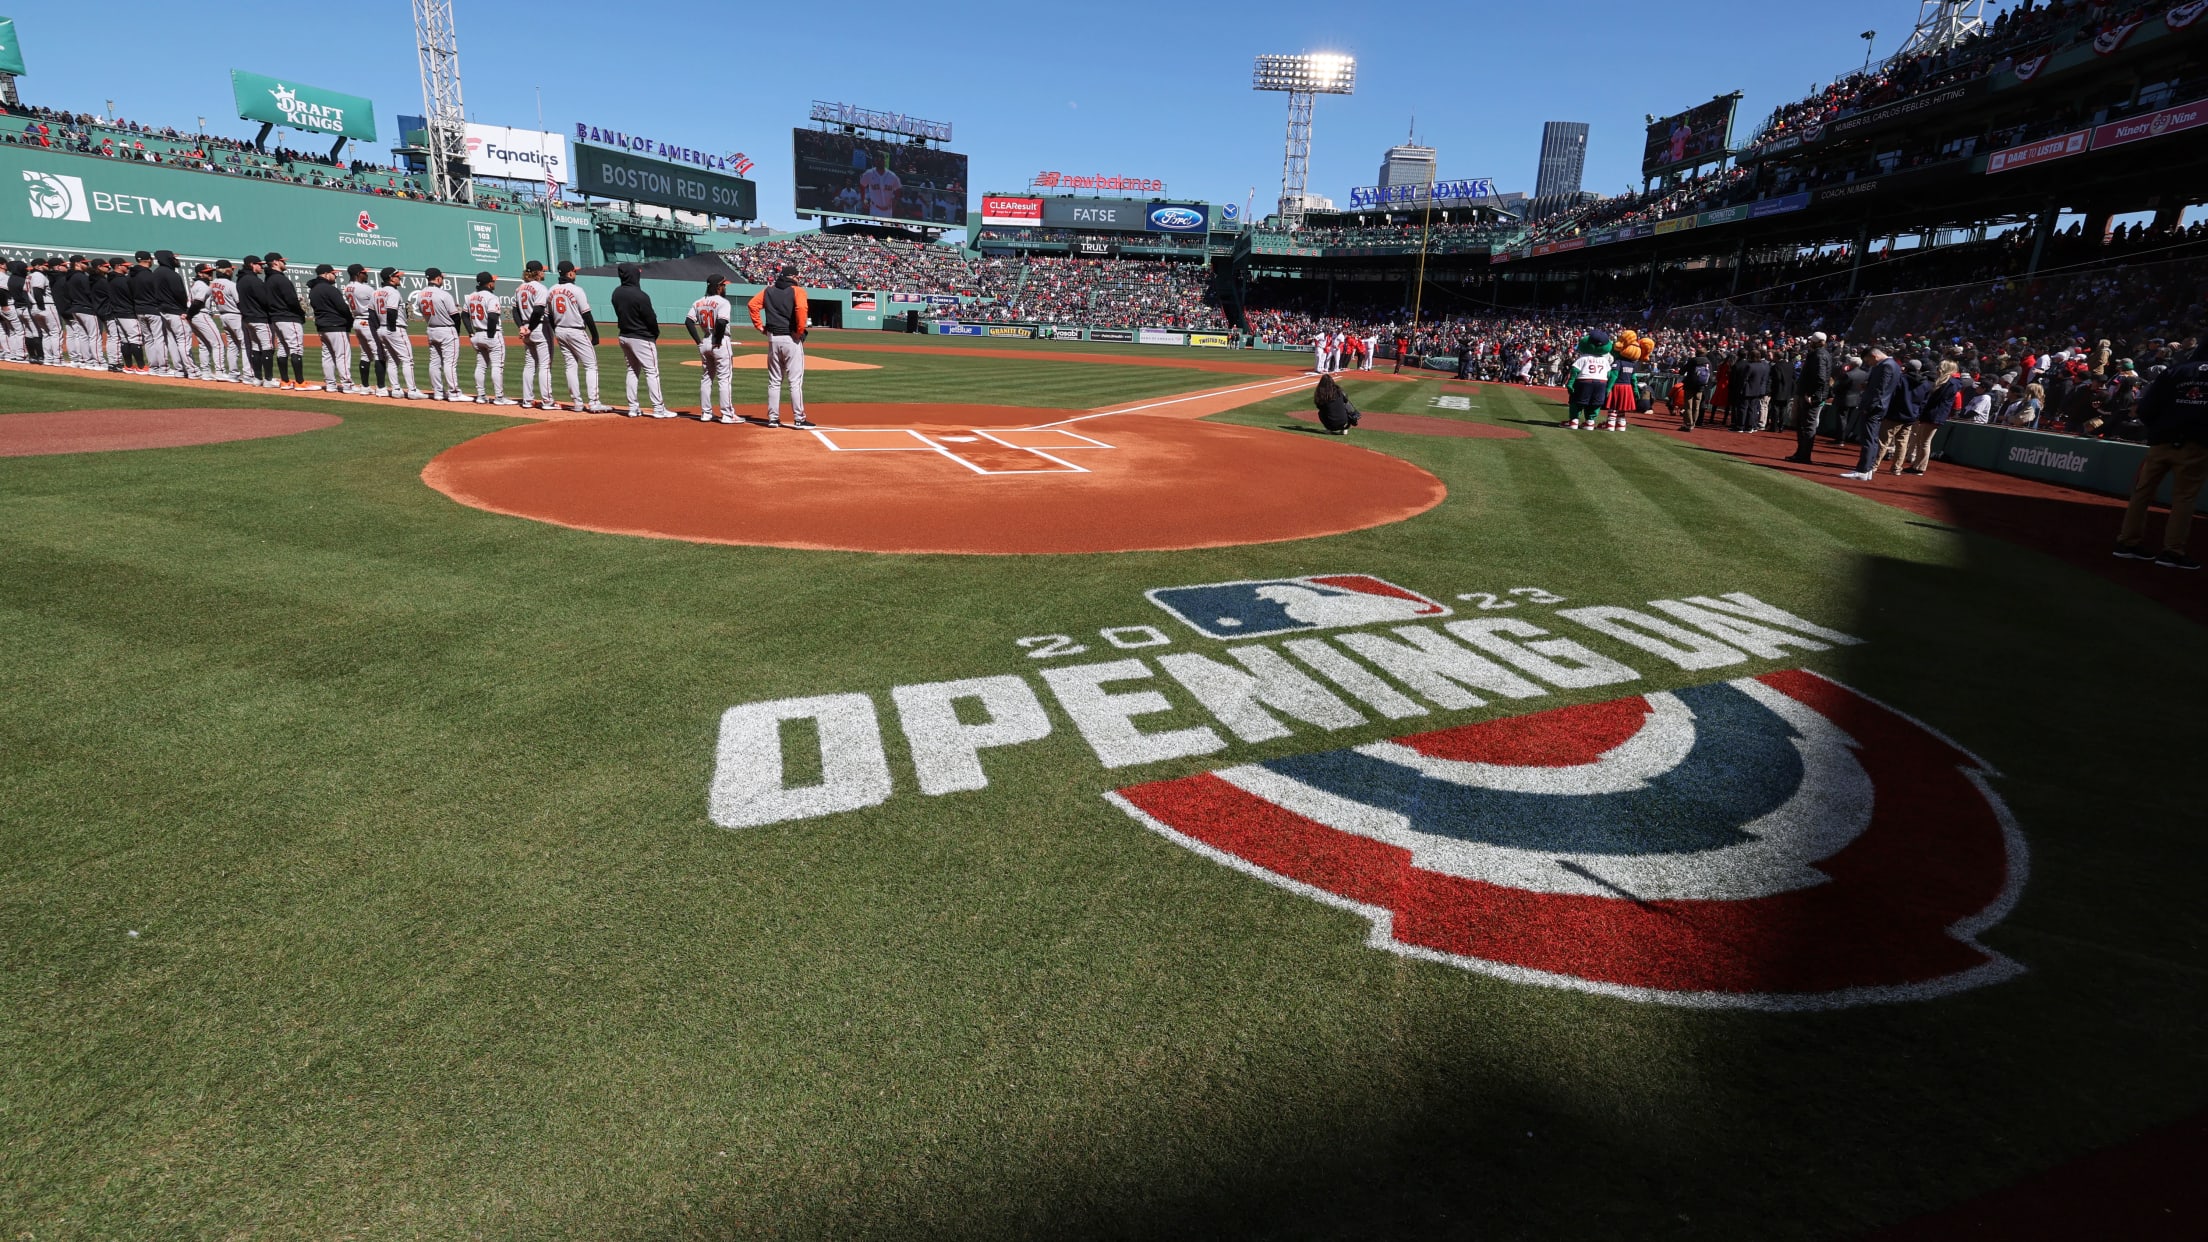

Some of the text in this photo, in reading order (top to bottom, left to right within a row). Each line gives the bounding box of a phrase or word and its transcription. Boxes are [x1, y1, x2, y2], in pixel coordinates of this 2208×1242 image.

[276, 97, 344, 120] DRAFT
[1834, 119, 1861, 133] NUMBER
[1872, 108, 1900, 123] CARLOS
[1933, 88, 1966, 104] HITTING
[287, 110, 344, 132] KINGS
[837, 101, 953, 142] MassMutual
[2115, 122, 2151, 138] Ninety
[2170, 111, 2198, 125] Nine
[576, 122, 726, 170] BANK OF AMERICA
[2007, 141, 2065, 164] DARE TO LISTEN
[602, 163, 740, 207] BOSTON RED SOX
[1350, 180, 1490, 208] SAMUEL ADAMS
[1847, 180, 1878, 194] NUMBER
[93, 191, 222, 223] BETMGM
[989, 201, 1037, 210] CLEAResult
[1073, 208, 1116, 222] FATSE
[556, 215, 589, 226] ABIOMED
[1161, 210, 1193, 225] Ford
[339, 236, 398, 248] FOUNDATION
[478, 232, 490, 240] 103
[1080, 243, 1108, 252] TRULY
[376, 297, 387, 315] 12
[420, 298, 435, 316] 21
[521, 291, 529, 310] 2
[556, 296, 567, 315] 6
[469, 303, 485, 321] 29
[700, 309, 715, 329] 31
[989, 327, 1032, 337] GRANITE CITY
[1588, 364, 1604, 374] 97
[2008, 446, 2089, 473] smartwater
[1016, 587, 1567, 659] 20 23
[708, 592, 1871, 829] OPENING DAY
